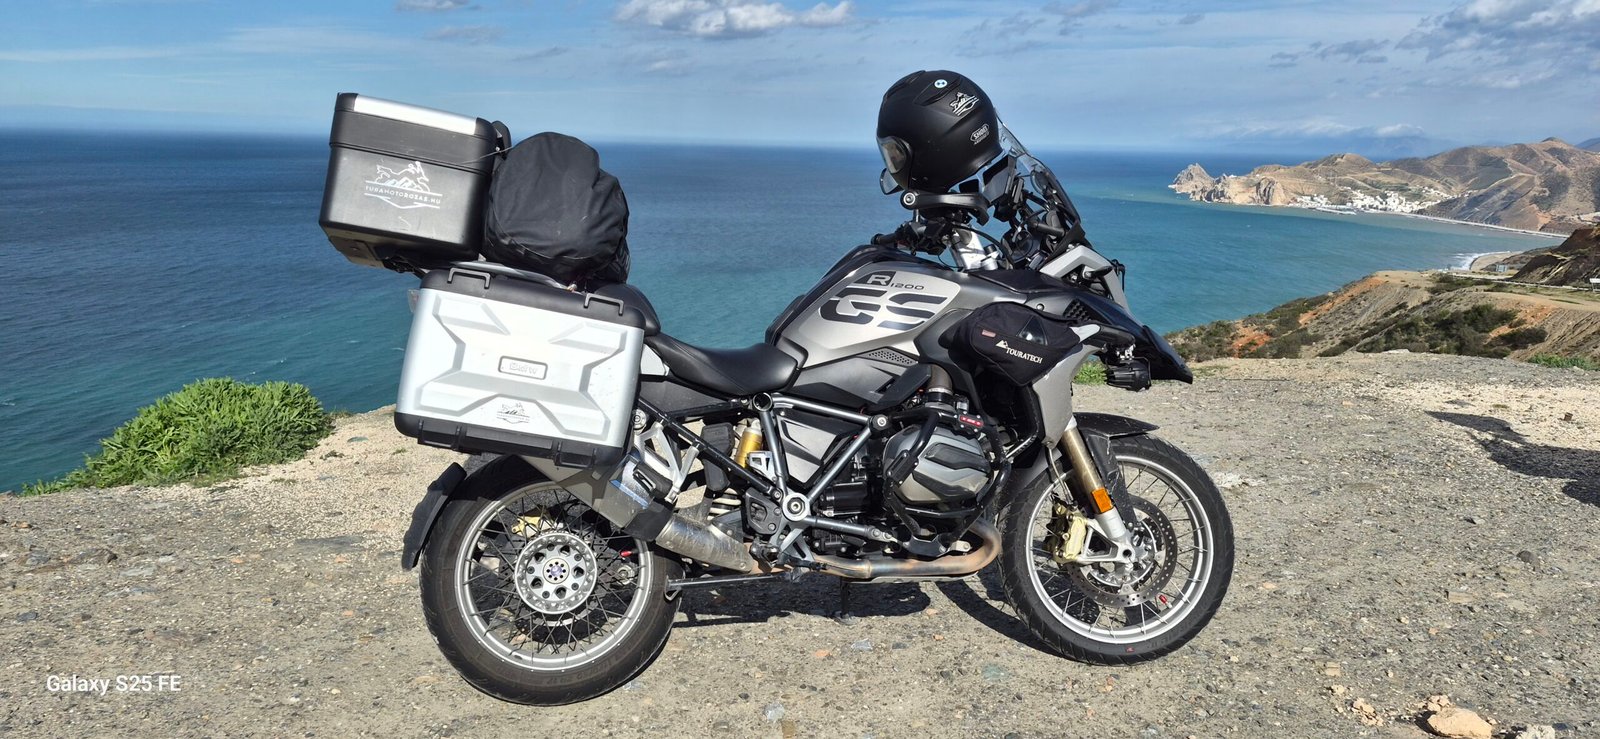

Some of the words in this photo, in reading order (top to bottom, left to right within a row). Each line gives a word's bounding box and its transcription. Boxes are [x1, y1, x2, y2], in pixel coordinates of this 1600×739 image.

[867, 274, 891, 286] R
[820, 287, 948, 331] GS
[1006, 347, 1043, 364] TOURATECH
